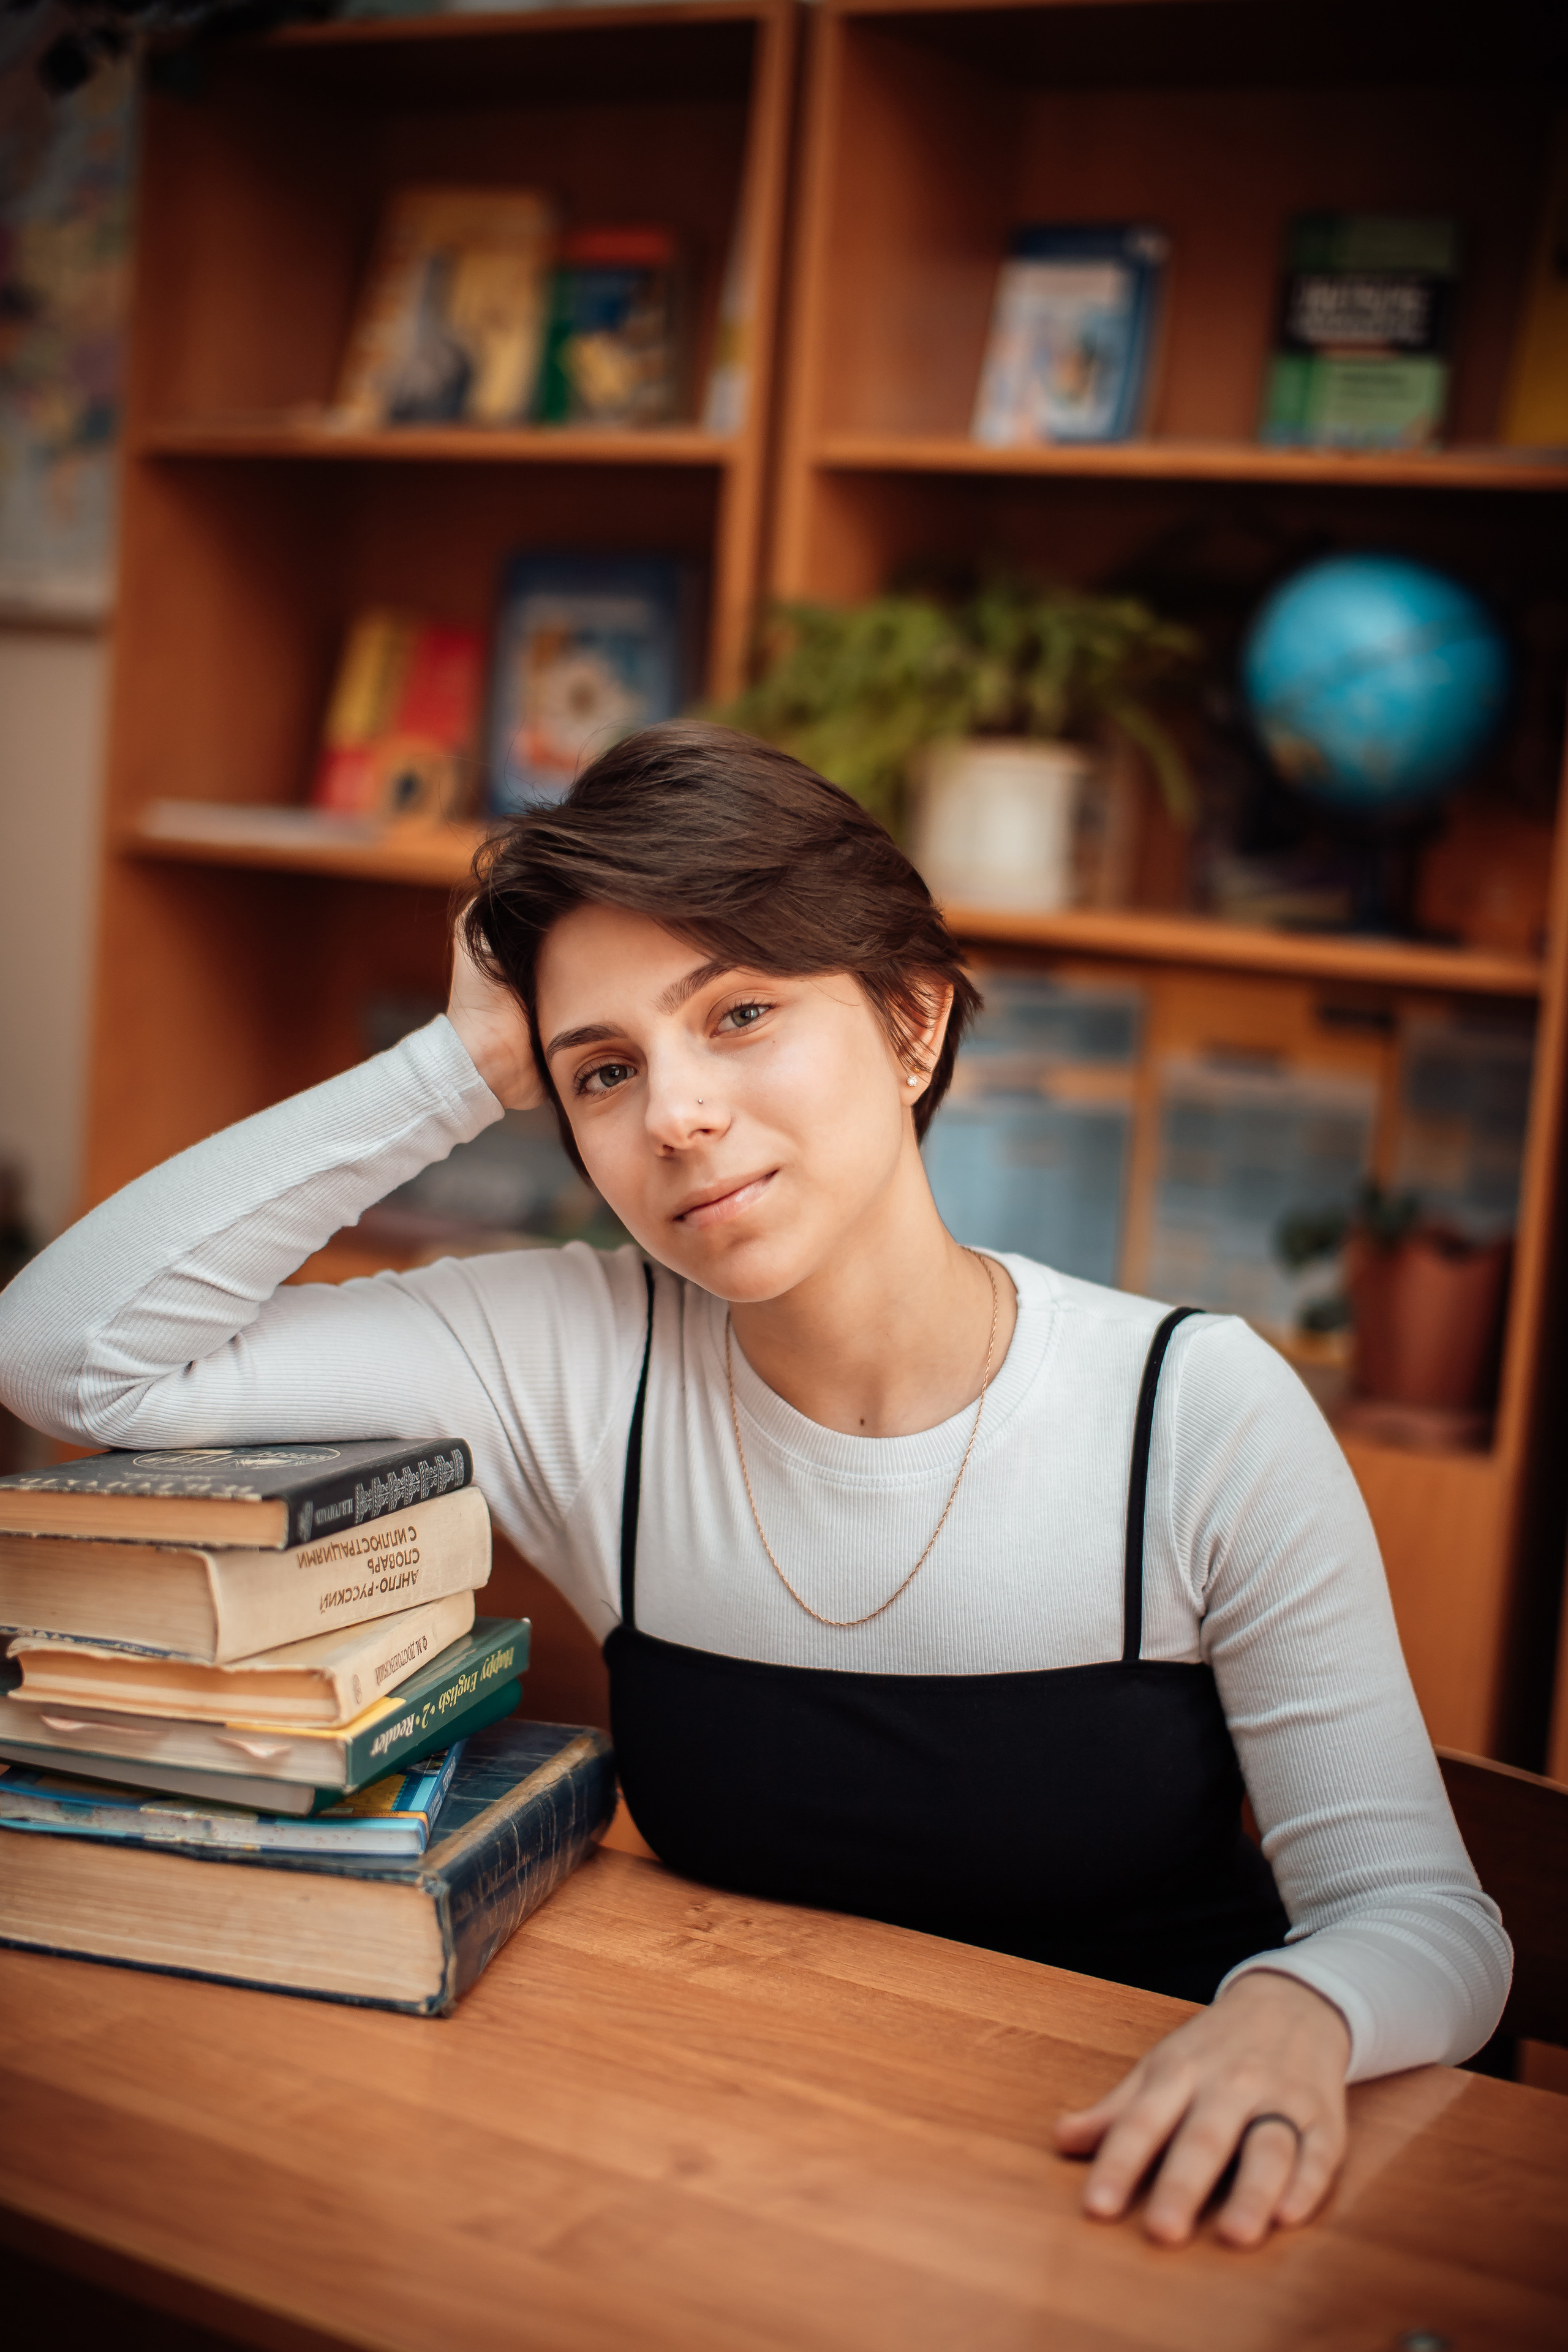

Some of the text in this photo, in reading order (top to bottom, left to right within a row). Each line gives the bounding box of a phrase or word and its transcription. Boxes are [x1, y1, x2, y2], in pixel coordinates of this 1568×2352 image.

[296, 1526, 418, 1569] С ИЛЛЮСТРАЦИЯМИ
[368, 1548, 421, 1574] СЛОВАРЬ
[320, 1569, 420, 1615] АНГЛО-РУССКИЙ
[480, 1647, 514, 1681] Happy
[438, 1670, 479, 1714] English
[370, 1713, 416, 1757] Reader
